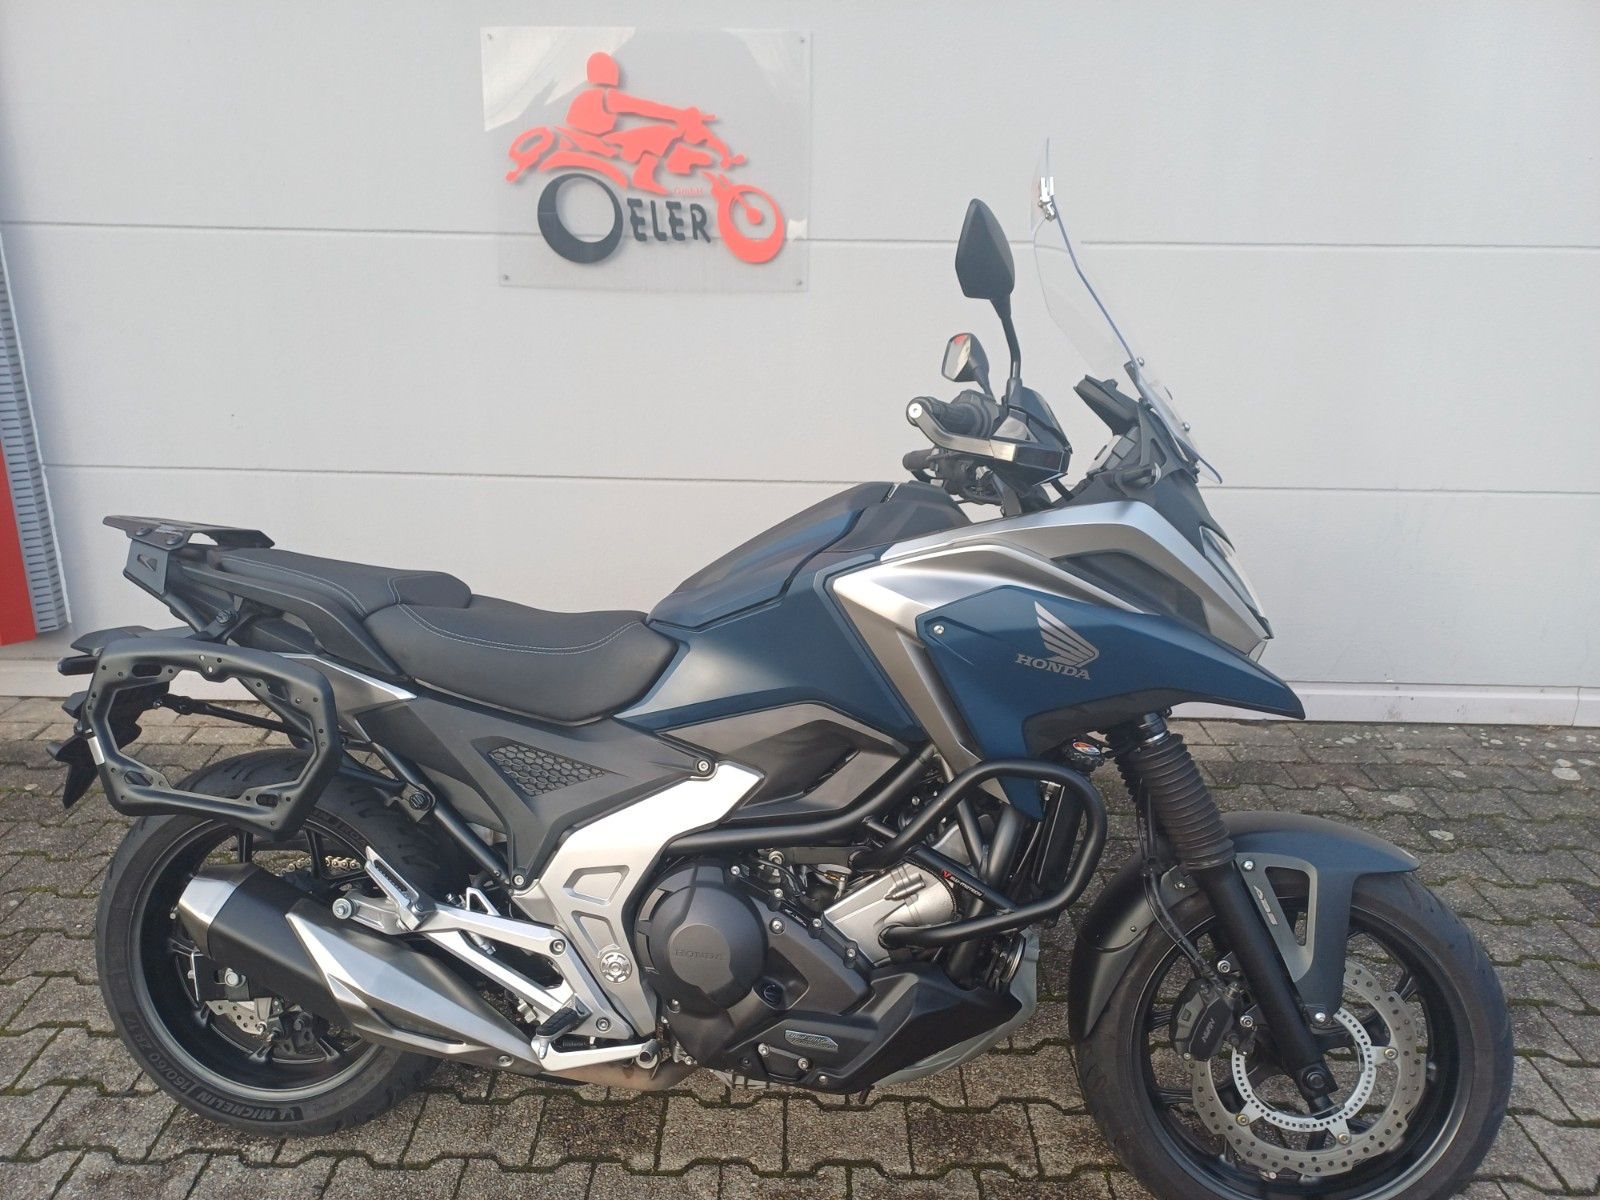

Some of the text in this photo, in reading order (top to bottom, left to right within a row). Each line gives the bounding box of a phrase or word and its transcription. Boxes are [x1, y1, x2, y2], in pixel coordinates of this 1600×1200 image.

[1015, 653, 1091, 680] HONDA
[148, 1052, 189, 1090] 160/60
[195, 1090, 276, 1120] MICHELIN
